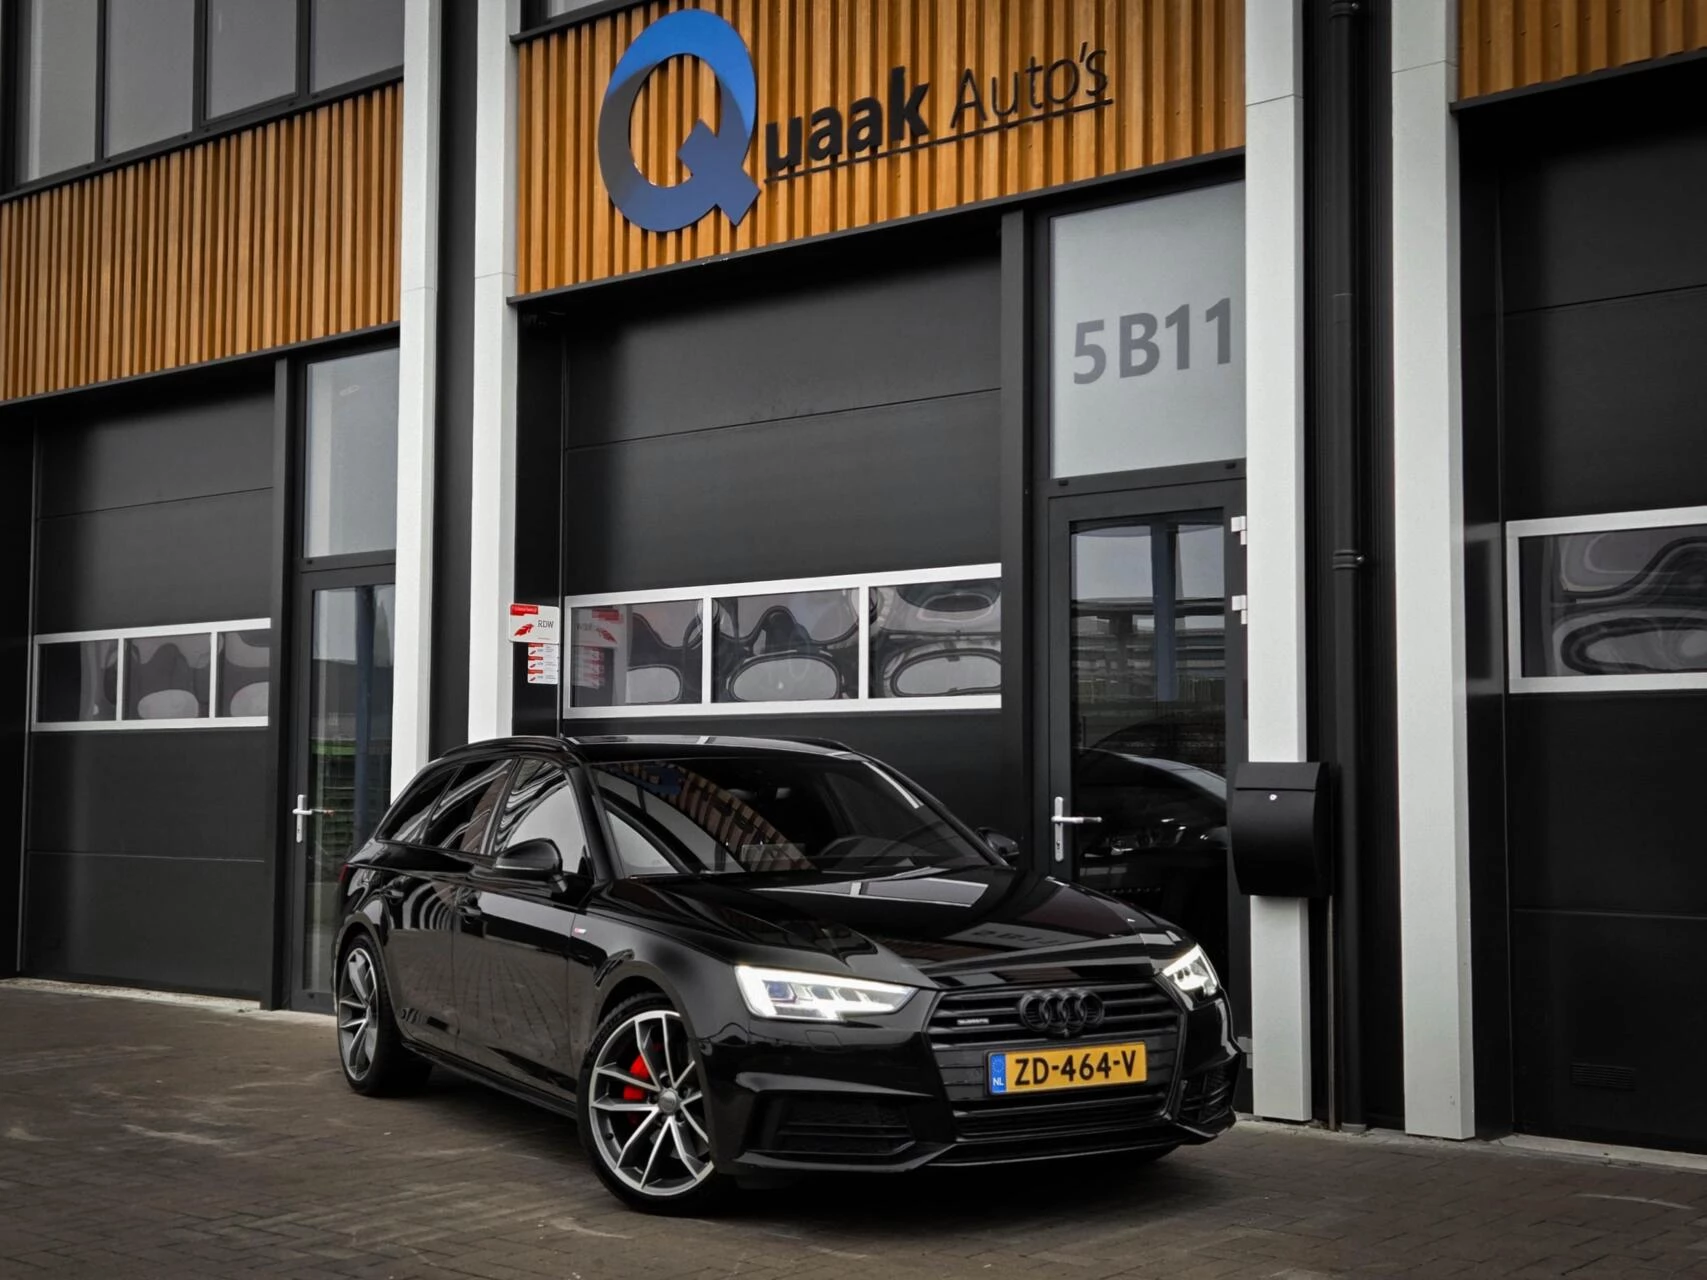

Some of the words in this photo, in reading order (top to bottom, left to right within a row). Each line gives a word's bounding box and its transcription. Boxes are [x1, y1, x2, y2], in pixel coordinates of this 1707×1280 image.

[951, 41, 1109, 129] Auto's
[537, 619, 555, 630] RDW
[1014, 1050, 1137, 1087] ZD-464-V
[992, 1077, 1005, 1087] NL
